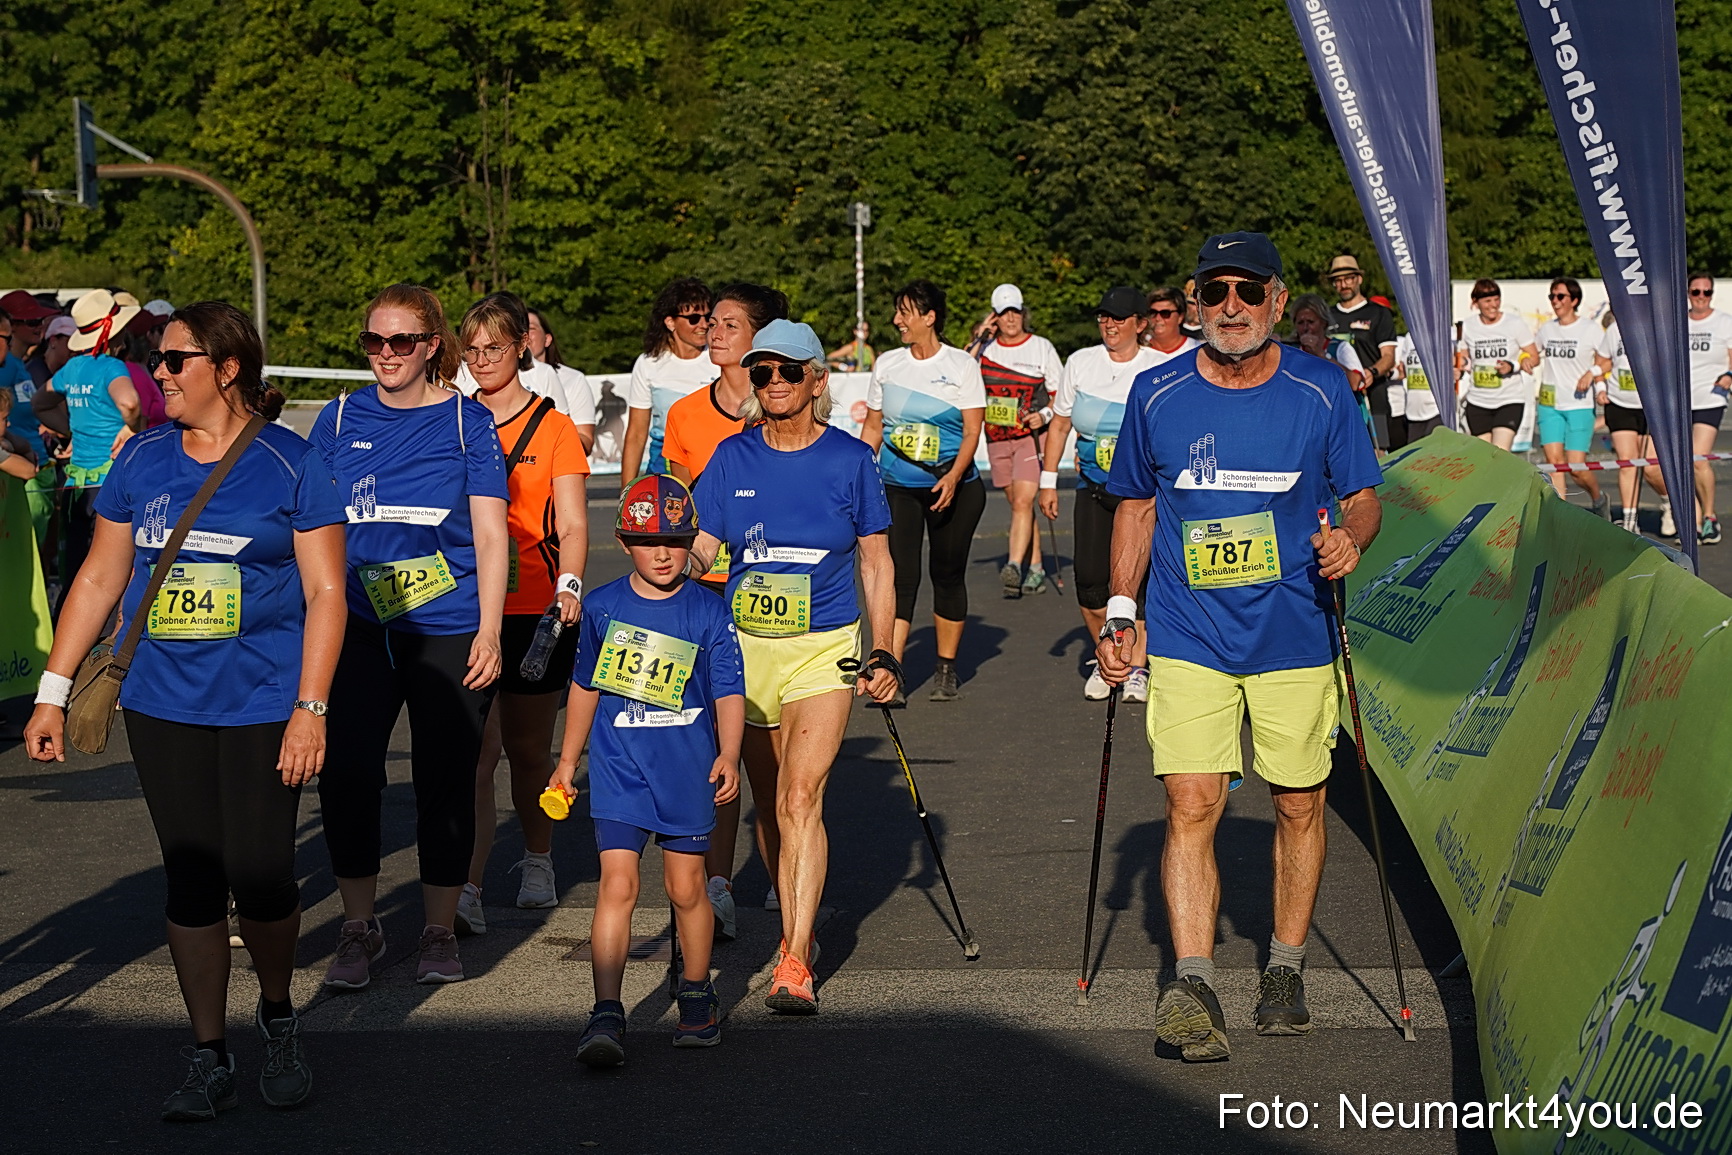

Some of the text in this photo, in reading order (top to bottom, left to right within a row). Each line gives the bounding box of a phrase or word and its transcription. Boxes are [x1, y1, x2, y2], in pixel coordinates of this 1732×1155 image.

[1475, 348, 1507, 359] BLÖD
[1545, 348, 1575, 358] BLÖD
[991, 406, 1008, 417] 159
[351, 441, 372, 450] JAKO
[1222, 473, 1288, 483] Schornsteintechnik
[735, 490, 756, 498] JAKO
[381, 508, 438, 517] Schornsteintechnik
[772, 549, 818, 557] Schornsteintechnik
[1206, 539, 1252, 566] 787
[1264, 539, 1275, 571] 2022
[1189, 548, 1201, 580] WALK
[1202, 563, 1264, 577] Schüßler Erich
[167, 590, 215, 614] 784
[370, 585, 389, 614] WALK
[387, 591, 412, 607] Brandl
[413, 579, 439, 595] Andrea
[226, 593, 235, 627] 2022
[749, 593, 788, 616] 790
[798, 600, 806, 628] 2022
[159, 616, 224, 625] Dobner Andrea
[742, 614, 795, 626] Schüßler Petra
[598, 647, 614, 680] WALK
[616, 648, 674, 684] 1341
[615, 672, 644, 687] Brandl
[645, 681, 664, 693] Emil
[672, 669, 686, 701] 2022
